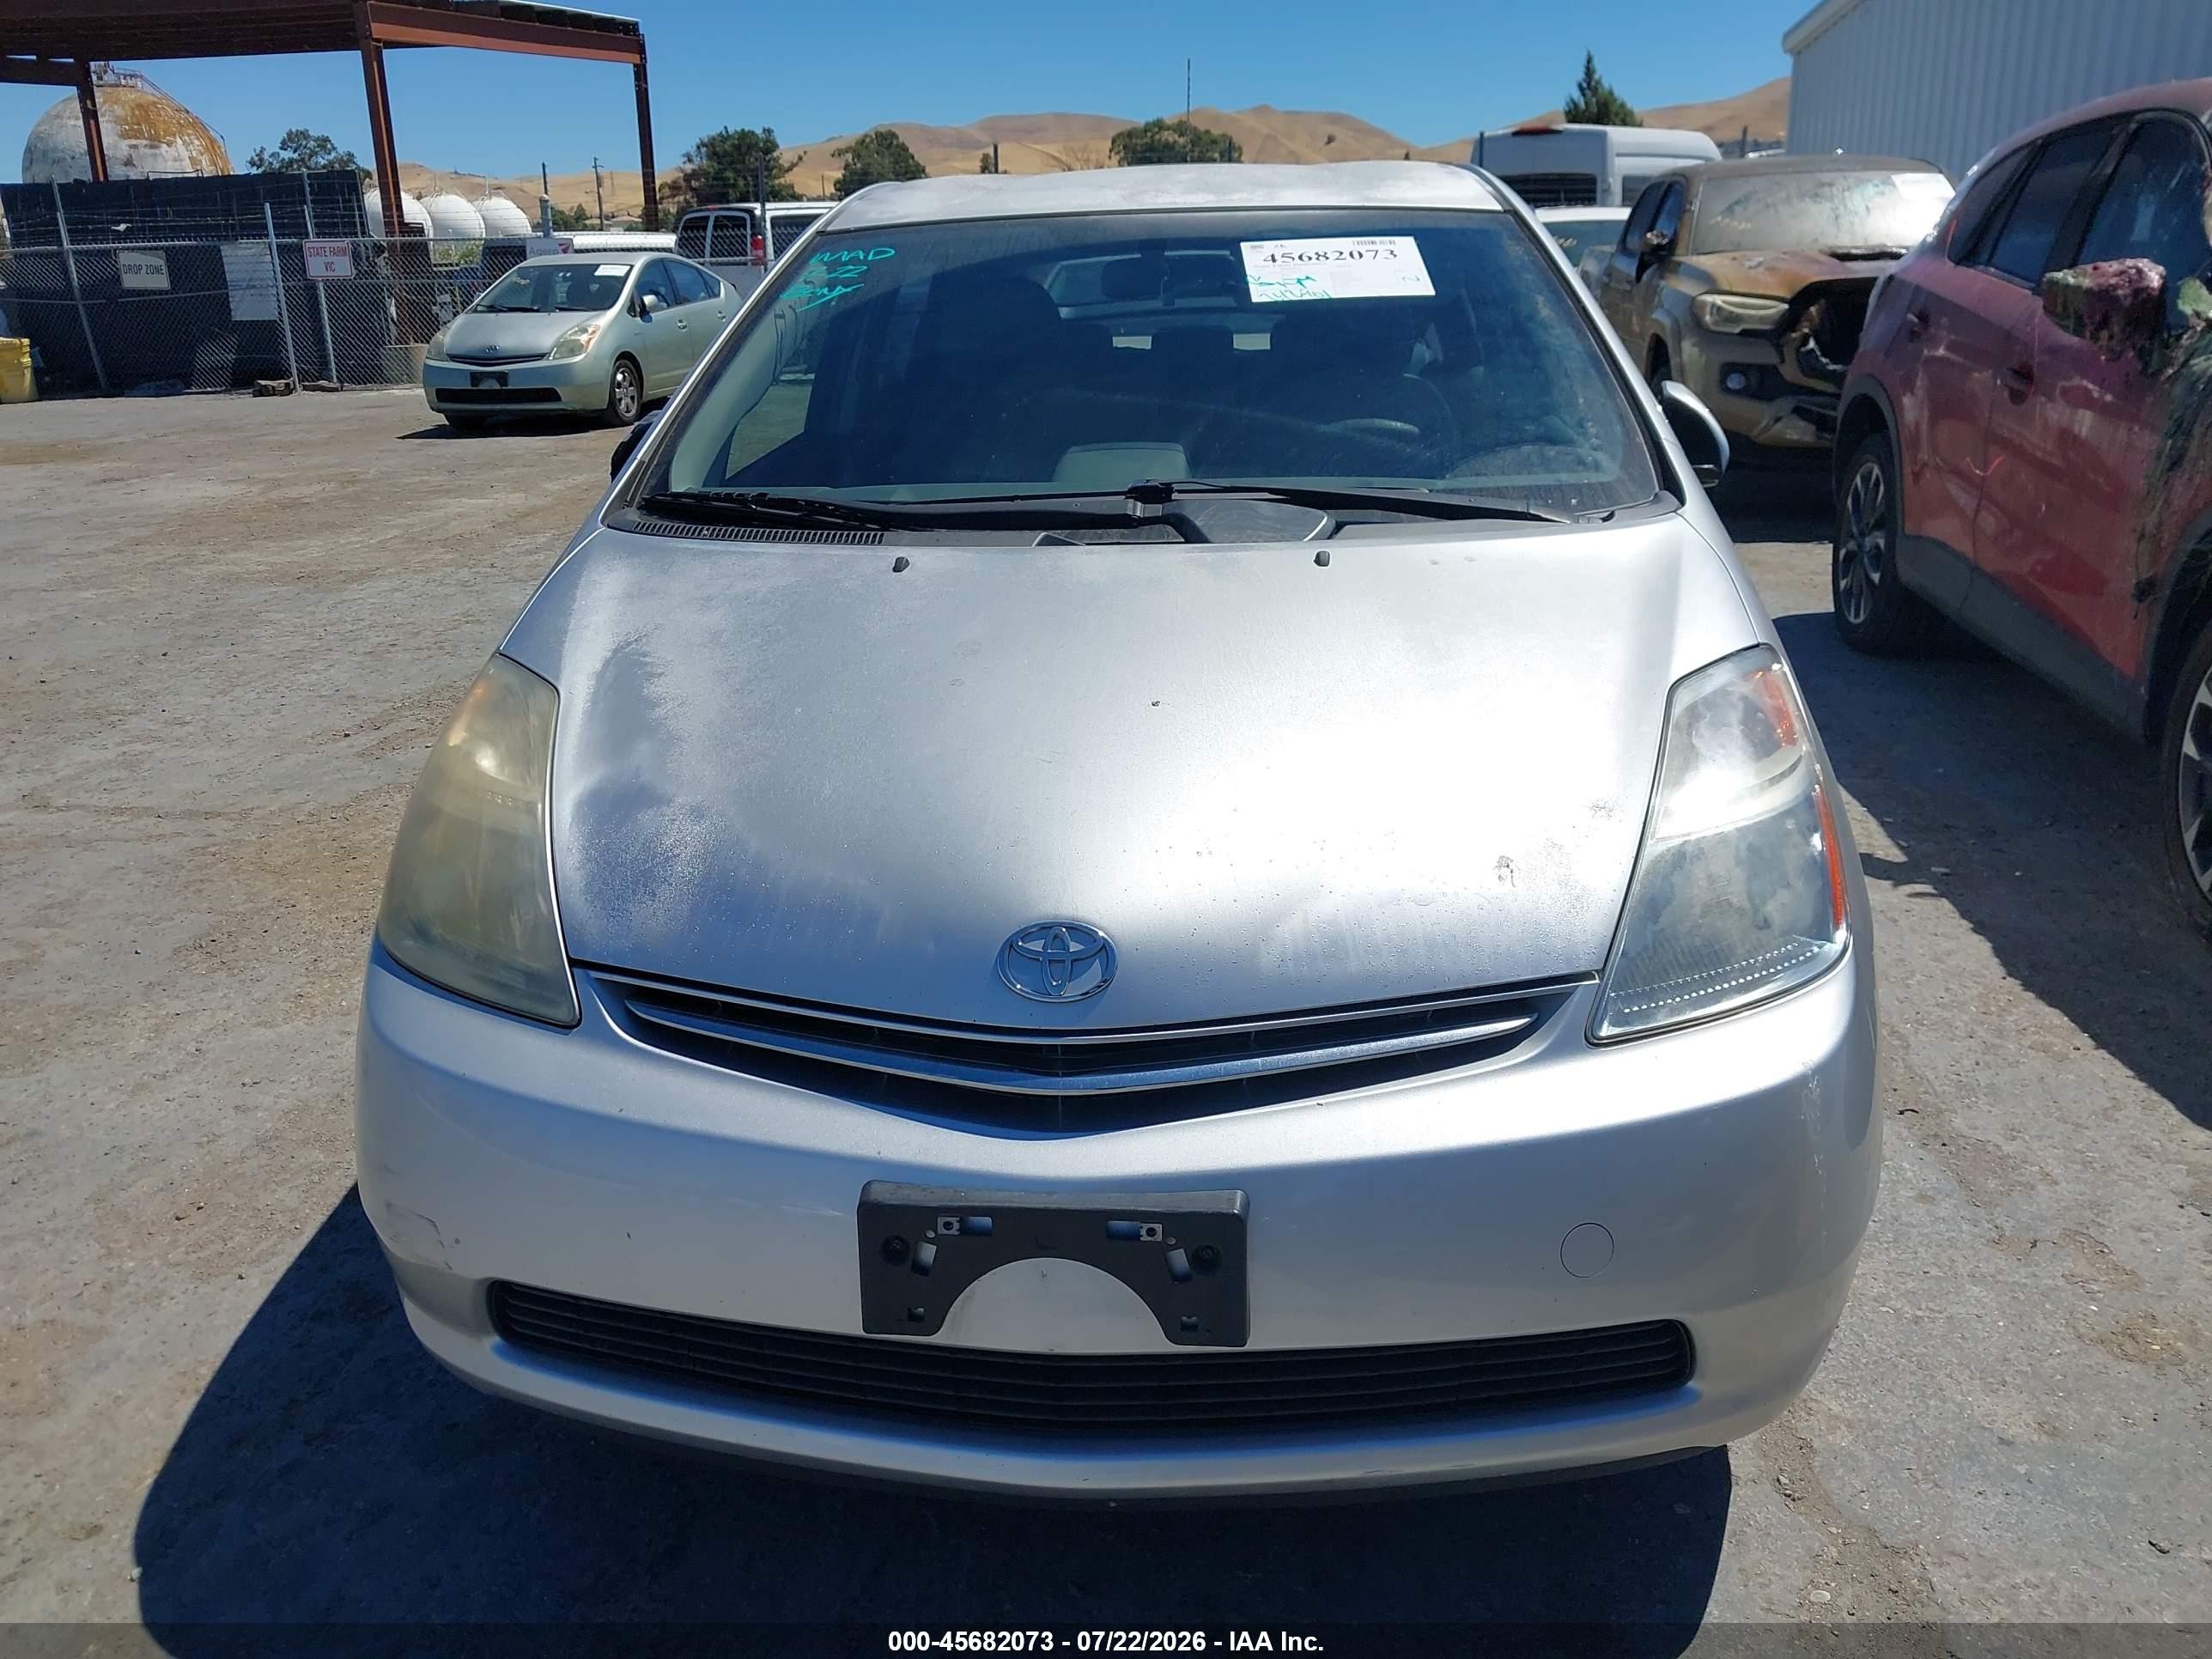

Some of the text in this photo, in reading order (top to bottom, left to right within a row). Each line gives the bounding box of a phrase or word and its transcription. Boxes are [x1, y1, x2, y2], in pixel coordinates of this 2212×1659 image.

[307, 246, 348, 258] STATE FARM
[1262, 249, 1398, 263] 45682073
[122, 264, 165, 275] DROP ZONE
[324, 261, 336, 272] VIC
